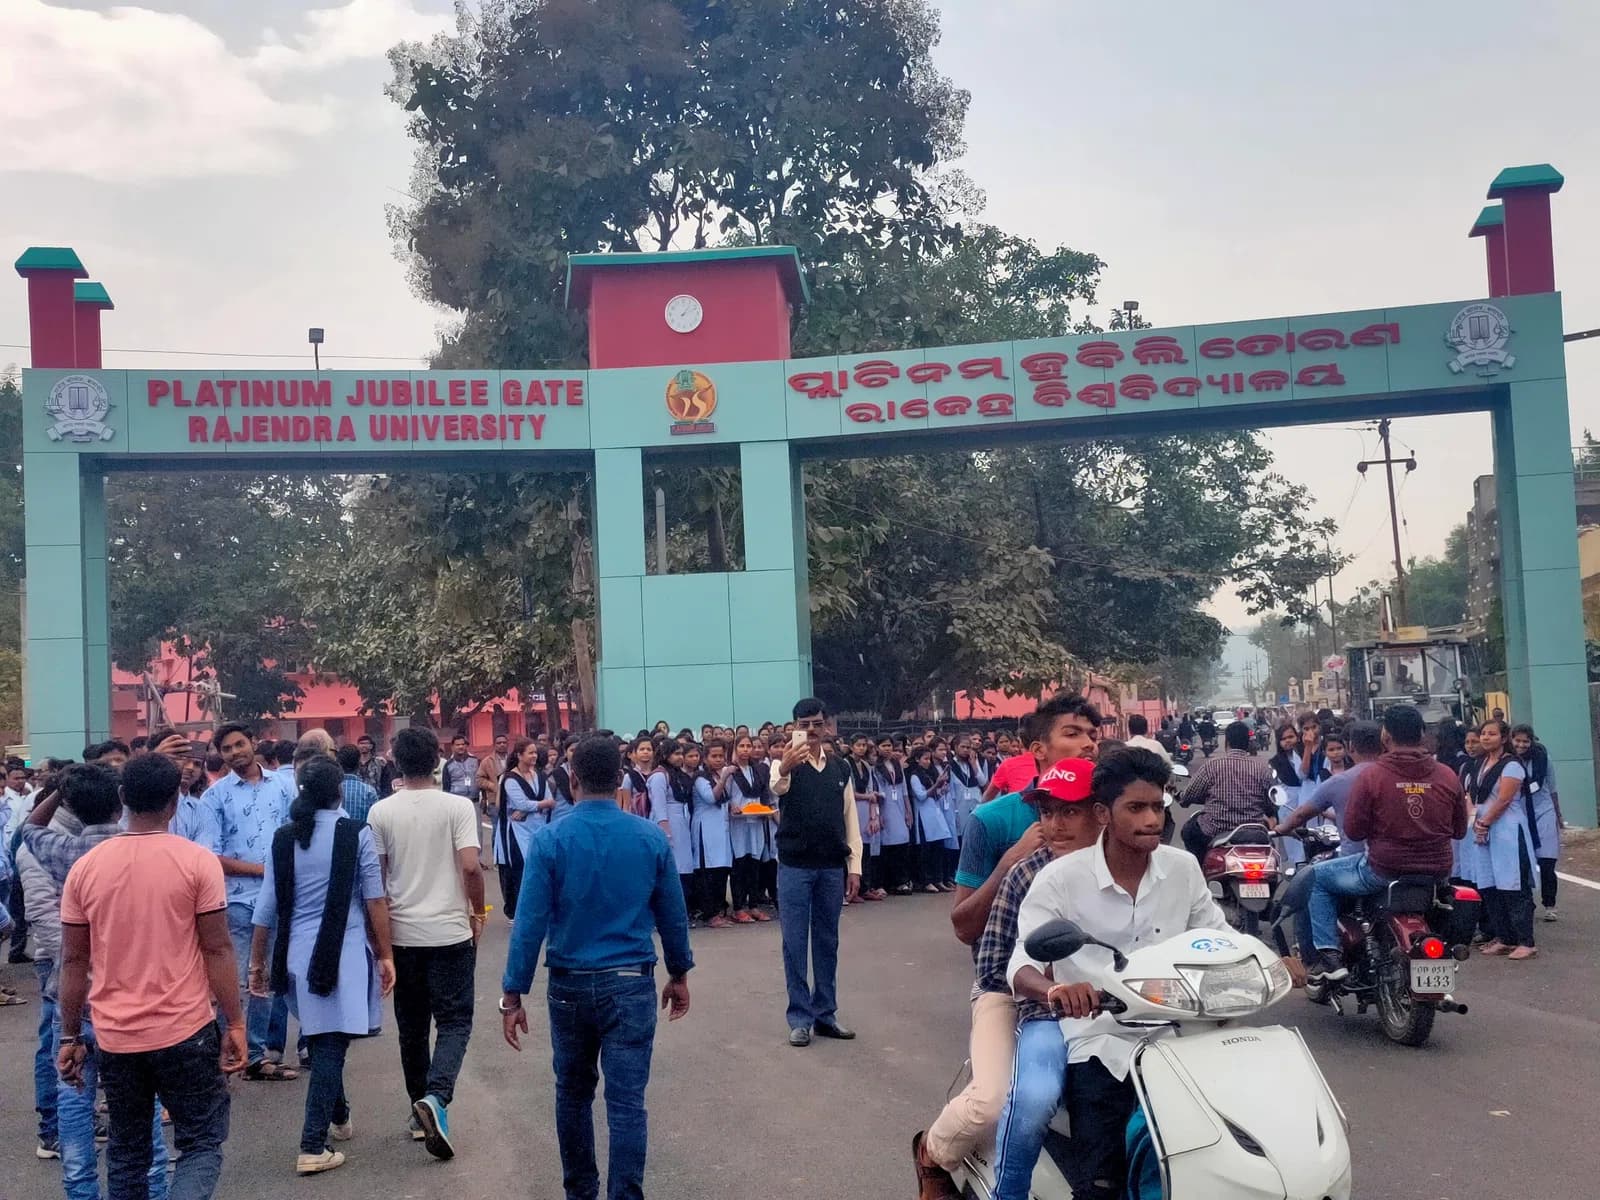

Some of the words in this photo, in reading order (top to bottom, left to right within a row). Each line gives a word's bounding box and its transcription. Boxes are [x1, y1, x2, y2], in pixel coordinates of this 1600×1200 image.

[1199, 322, 1400, 359] ତୋରଣ
[147, 379, 332, 408] PLATINUM
[346, 379, 488, 407] JUBILEE
[502, 379, 584, 407] GATE
[188, 415, 356, 443] RAJENDRA
[369, 414, 547, 442] UNIVERSITY
[1415, 975, 1450, 988] 1433
[1221, 1035, 1262, 1046] HONDA
